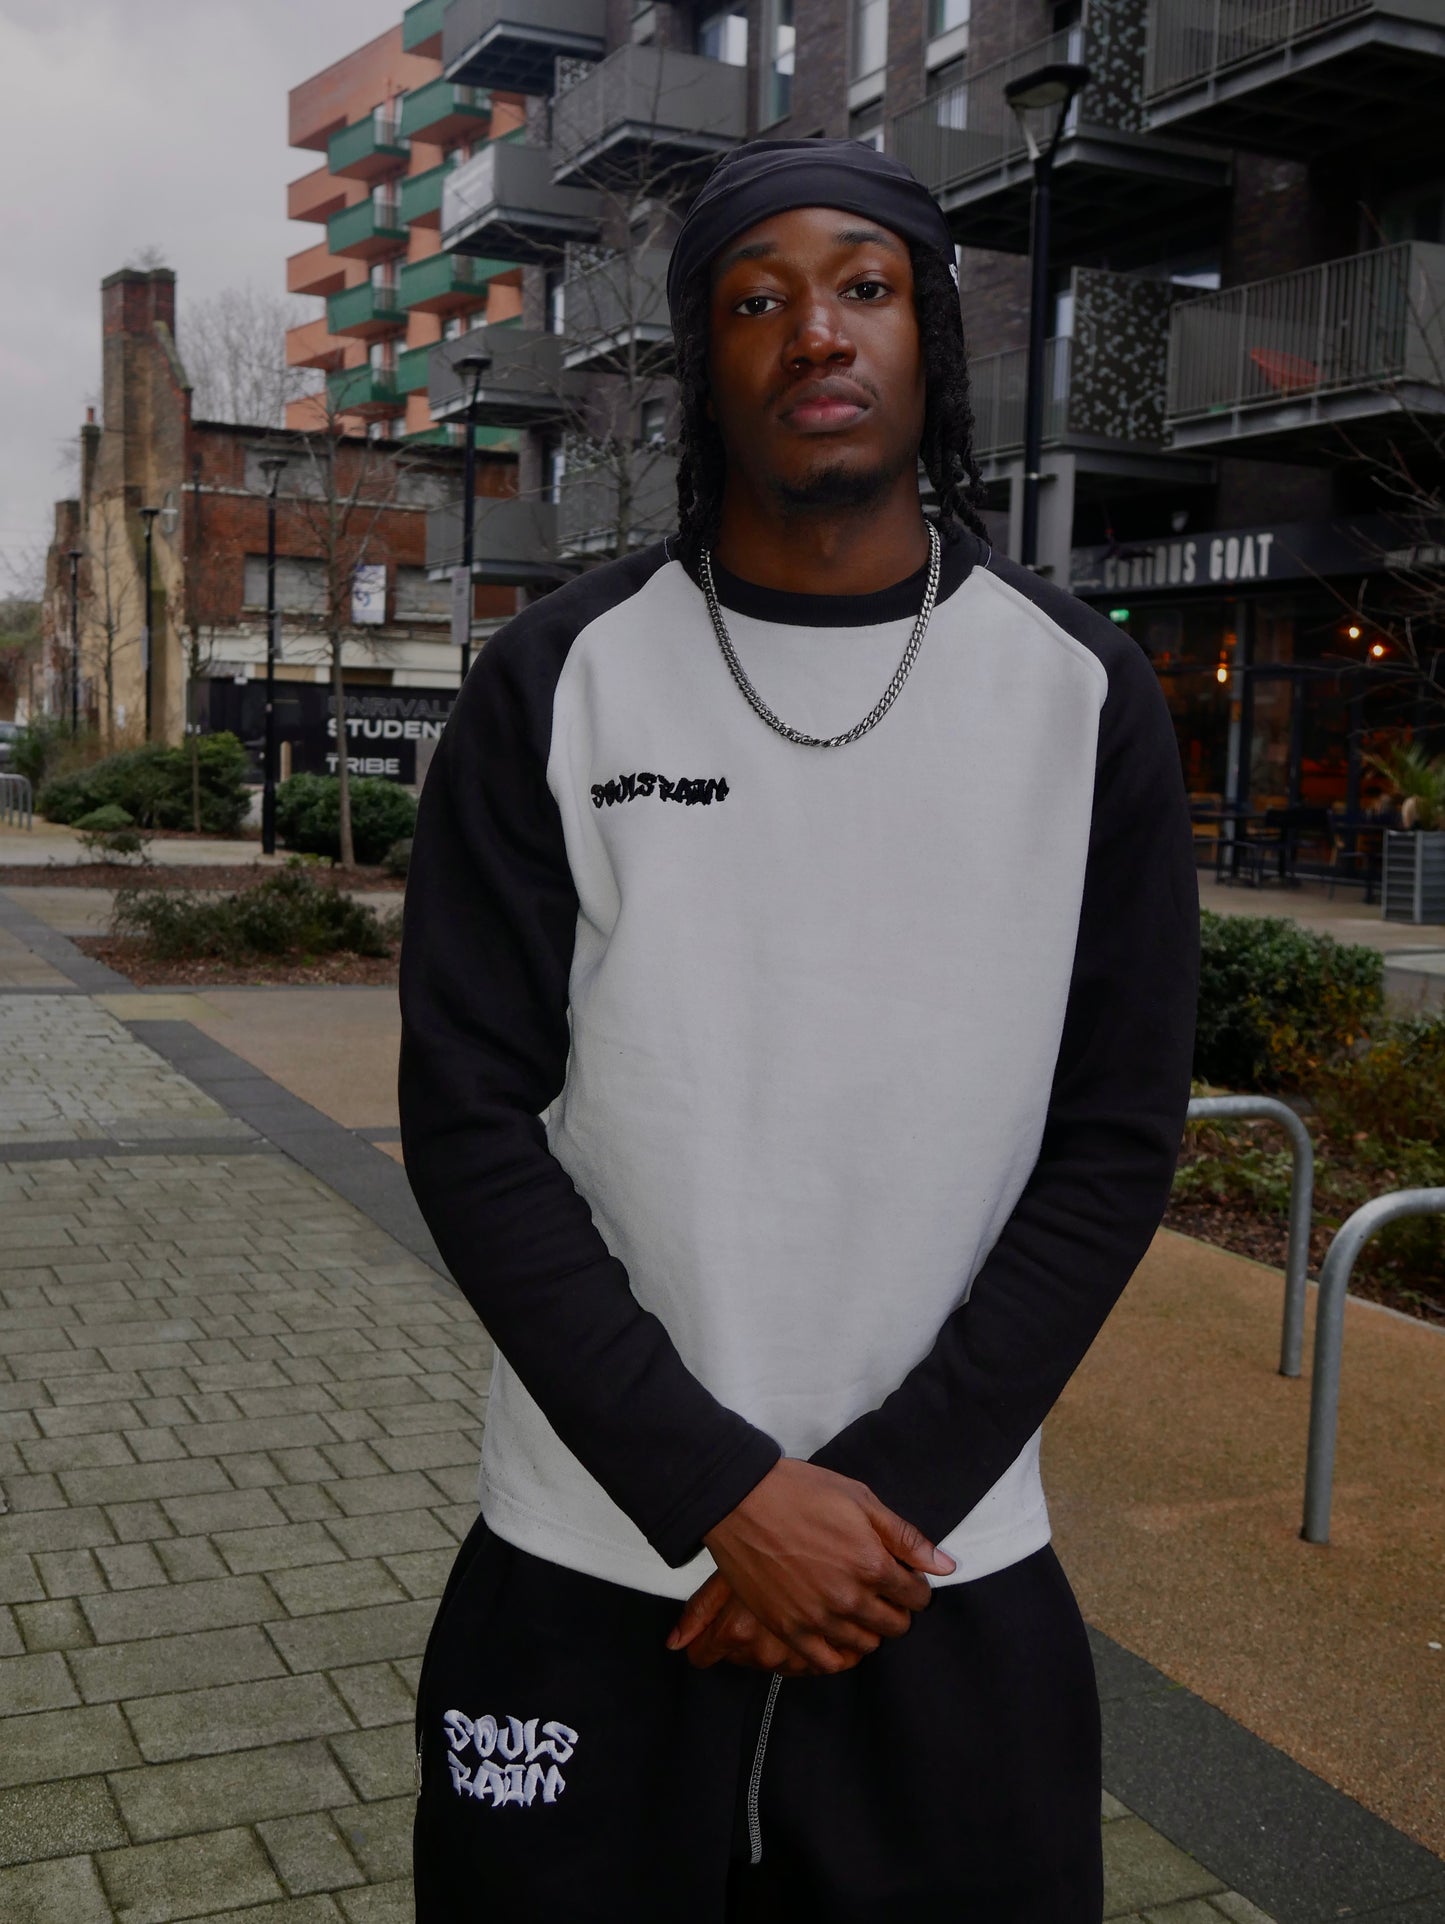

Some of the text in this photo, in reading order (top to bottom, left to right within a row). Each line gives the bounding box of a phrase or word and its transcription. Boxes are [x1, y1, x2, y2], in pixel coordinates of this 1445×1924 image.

[1209, 533, 1274, 581] GOAT
[325, 757, 401, 774] TRIBE
[443, 1709, 580, 1764] SOULS
